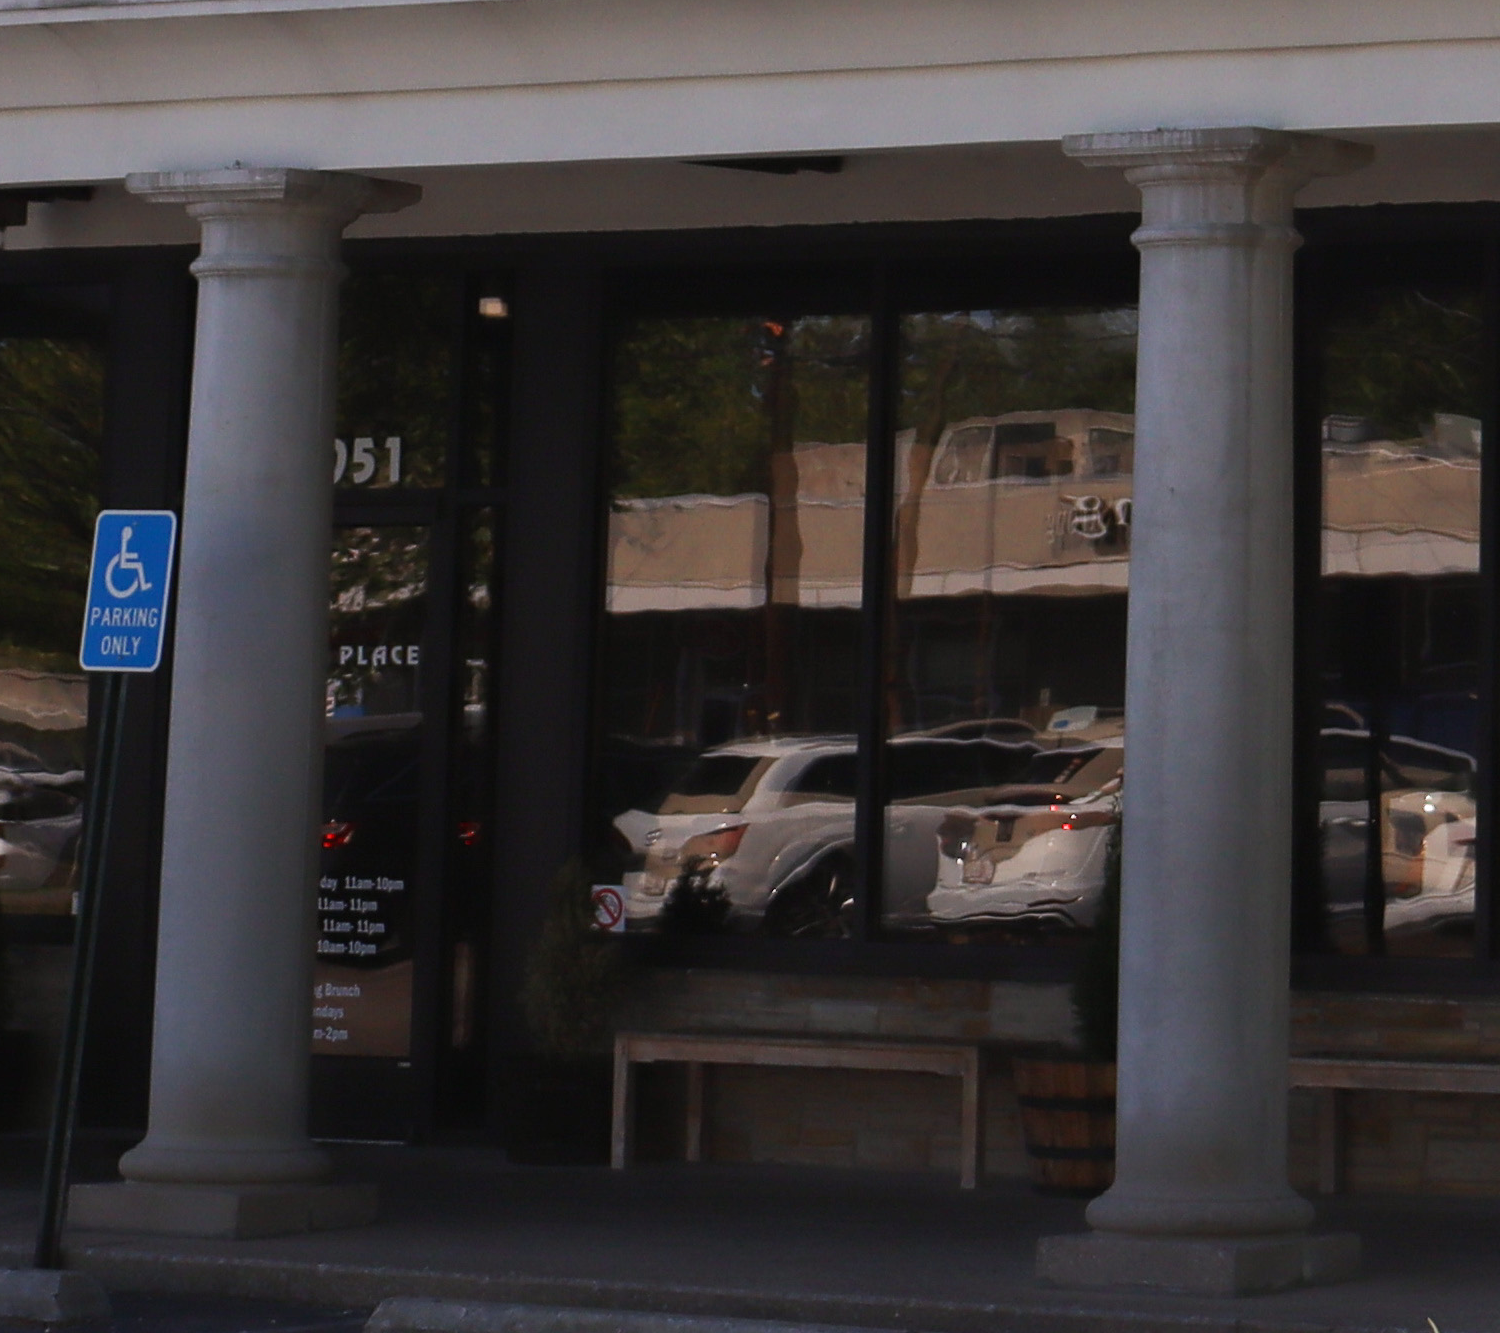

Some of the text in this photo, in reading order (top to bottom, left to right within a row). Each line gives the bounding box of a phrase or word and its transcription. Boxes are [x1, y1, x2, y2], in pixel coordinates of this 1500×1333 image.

[91, 607, 159, 627] PARKING
[101, 636, 141, 655] ONLY
[340, 645, 420, 665] PLACE
[325, 984, 360, 996] Brunch
